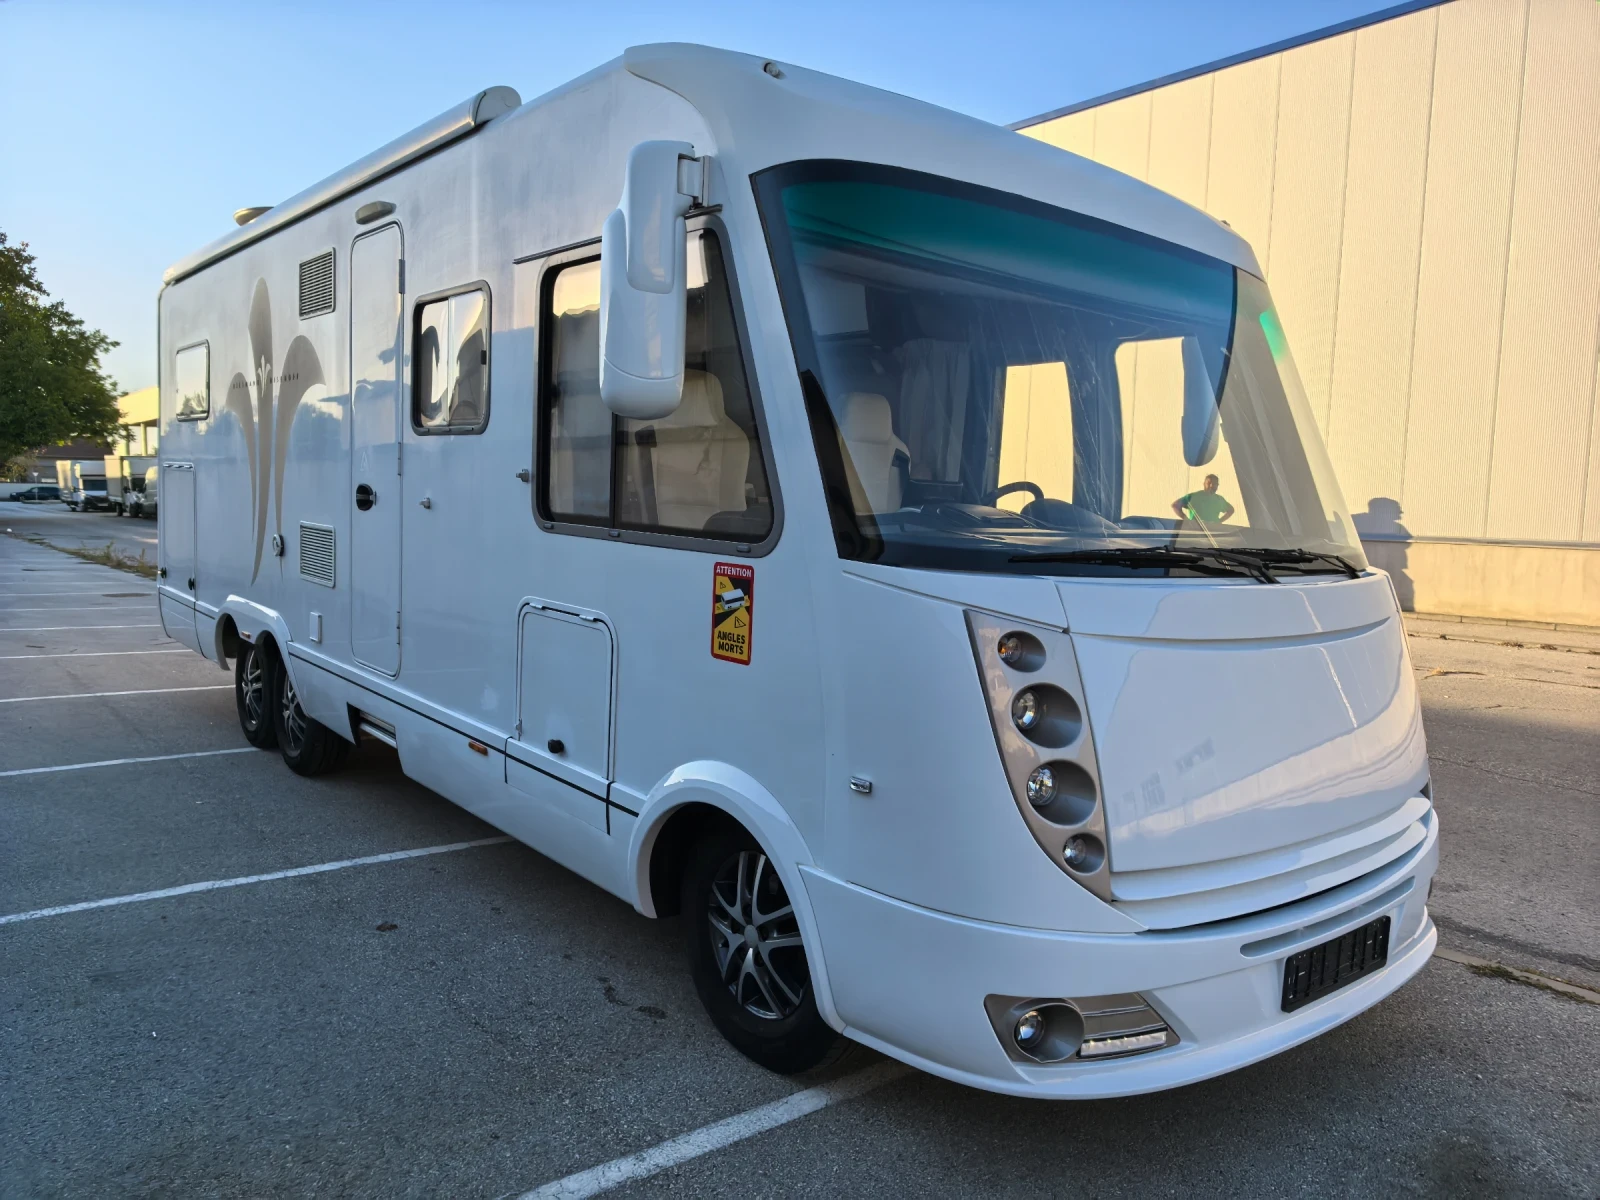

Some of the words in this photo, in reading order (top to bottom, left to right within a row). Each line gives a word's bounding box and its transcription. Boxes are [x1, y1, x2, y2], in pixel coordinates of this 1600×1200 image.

[716, 566, 752, 577] ATTENTION
[717, 631, 745, 644] ANGLES
[718, 641, 744, 655] MORTS
